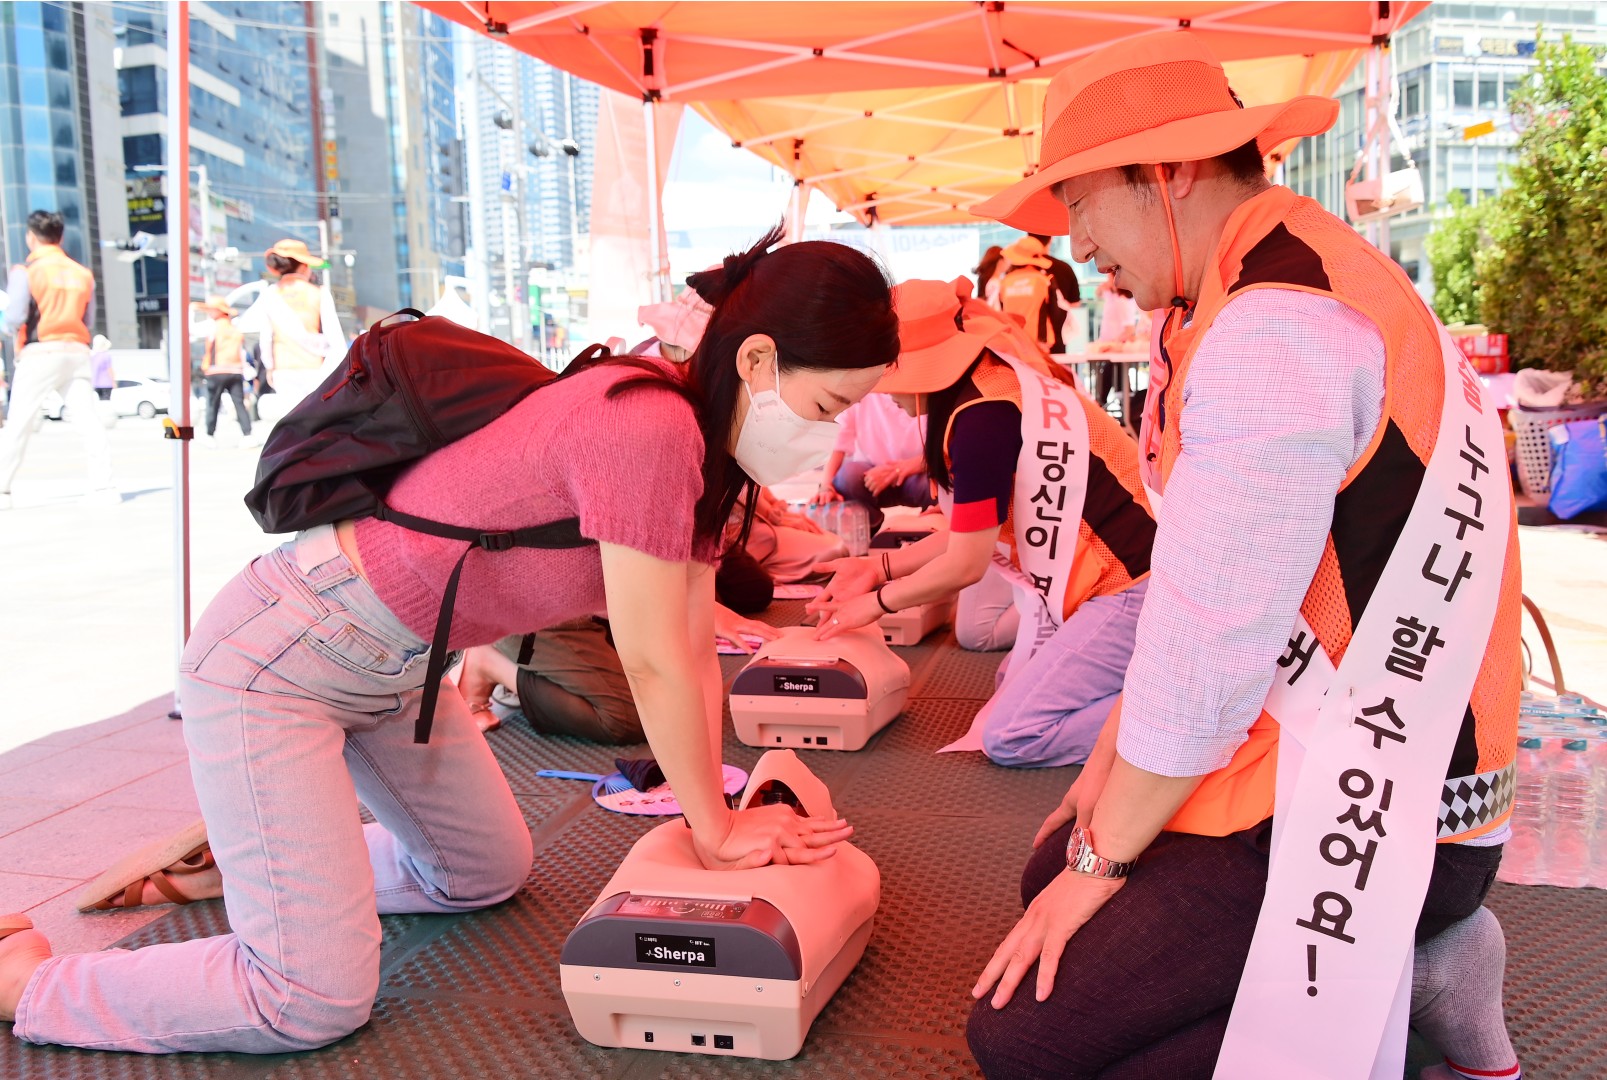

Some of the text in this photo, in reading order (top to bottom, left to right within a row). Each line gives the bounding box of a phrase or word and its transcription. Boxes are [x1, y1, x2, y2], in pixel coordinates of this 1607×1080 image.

[1025, 440, 1075, 560] 당신이
[1421, 424, 1490, 603] 누구나
[1384, 615, 1445, 682] 할
[783, 681, 814, 692] Sherpa
[1354, 696, 1407, 750] 수
[1296, 768, 1393, 997] 있어요!
[653, 946, 705, 963] Sherpa
